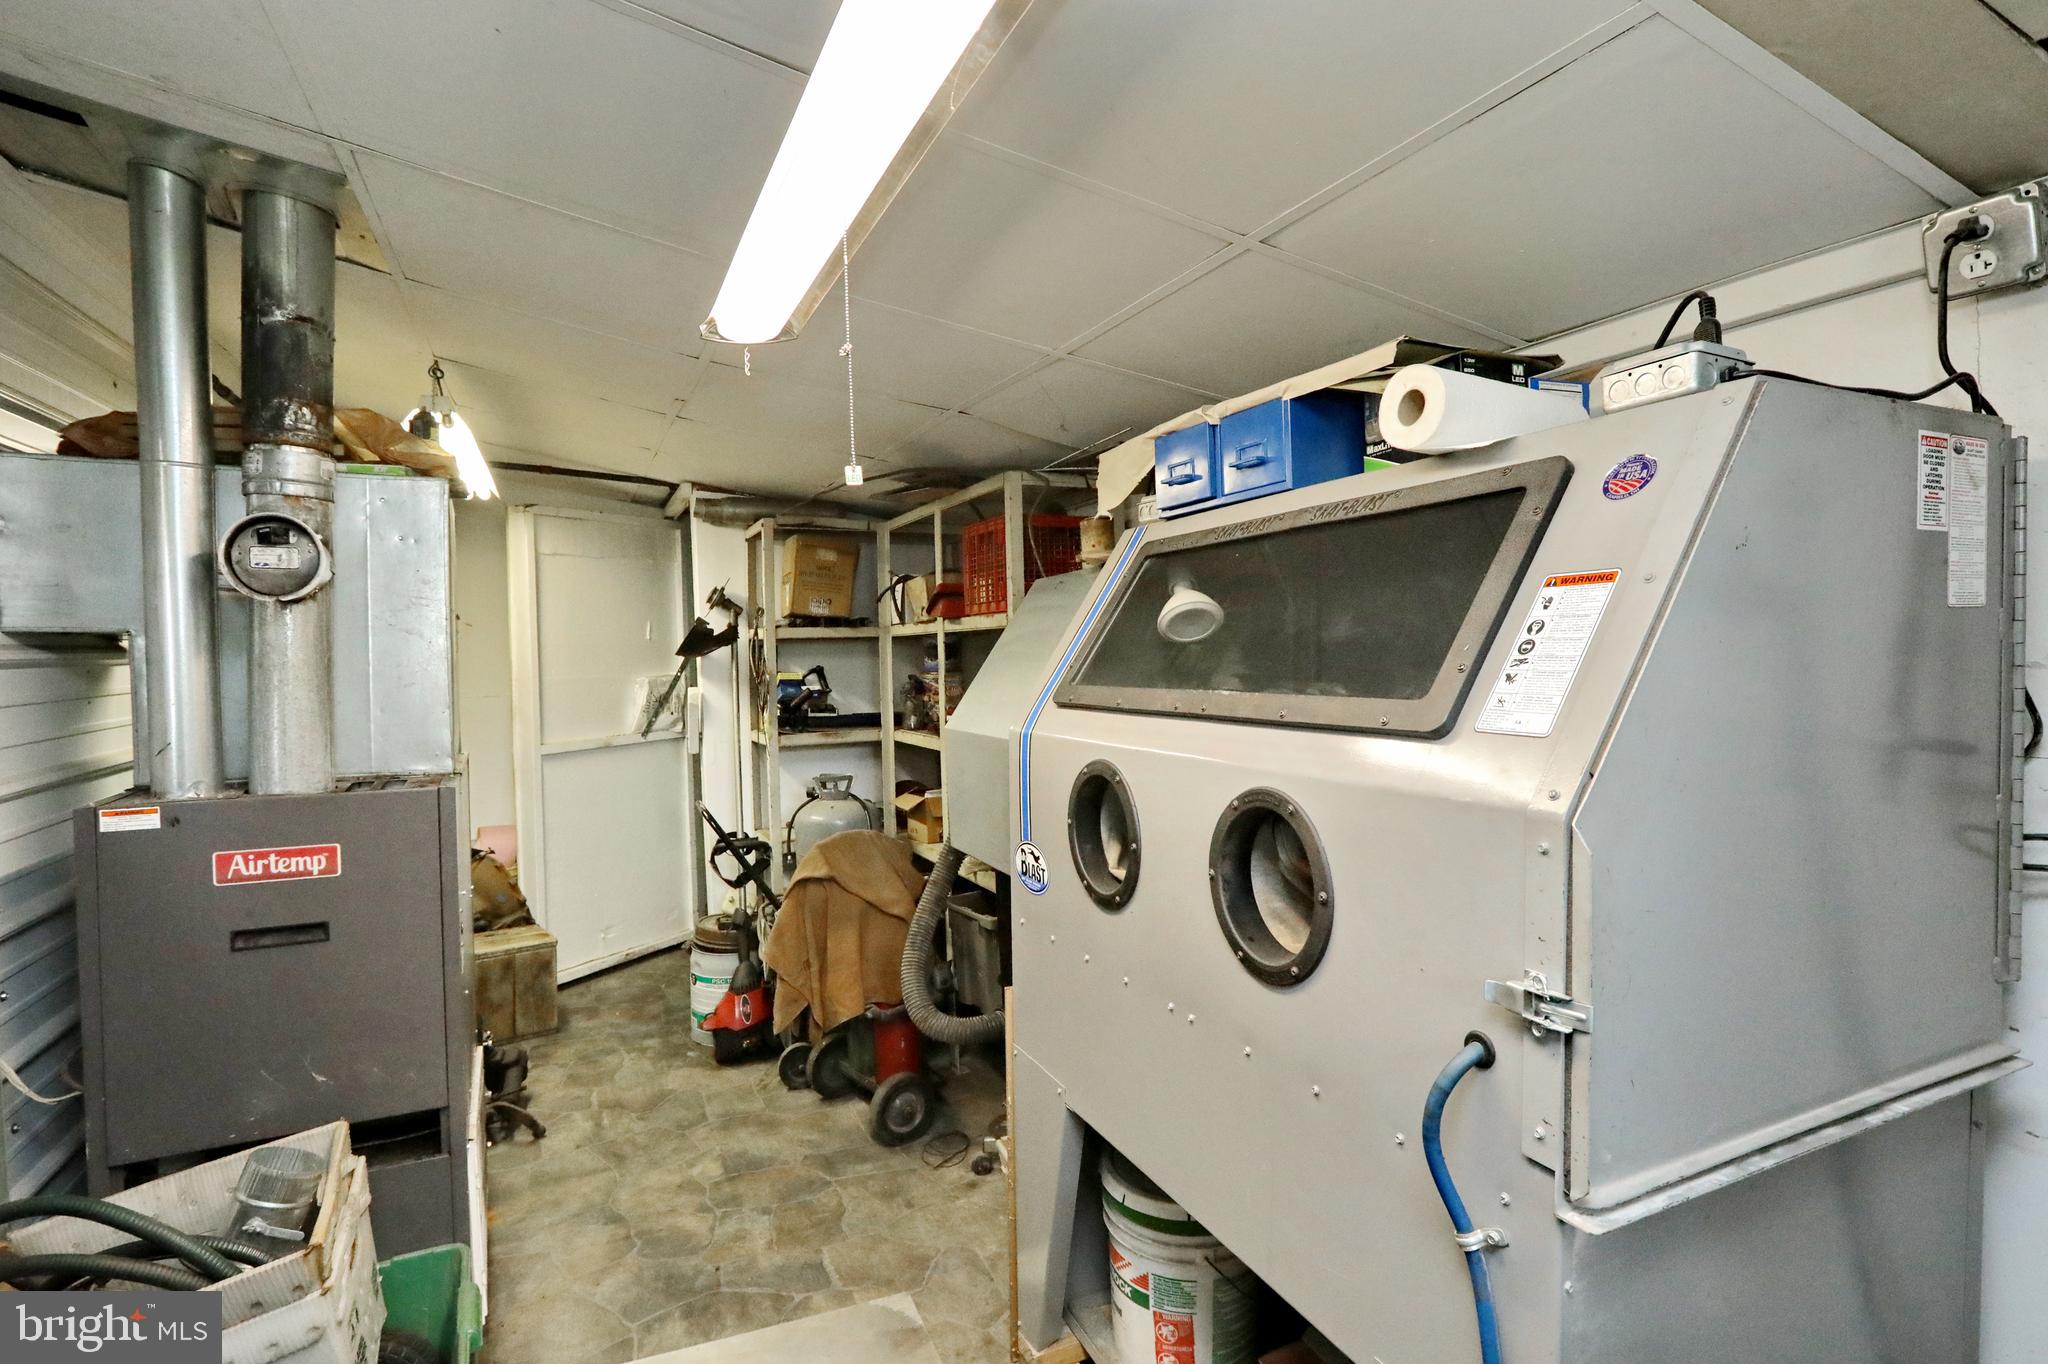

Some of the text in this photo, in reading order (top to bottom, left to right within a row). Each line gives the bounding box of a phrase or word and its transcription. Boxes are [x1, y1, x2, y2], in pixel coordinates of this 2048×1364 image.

[1511, 375, 1525, 383] LED
[1619, 464, 1642, 474] MADE
[1625, 469, 1648, 481] USA
[1560, 573, 1613, 585] WARNING
[227, 853, 327, 879] Airtemp
